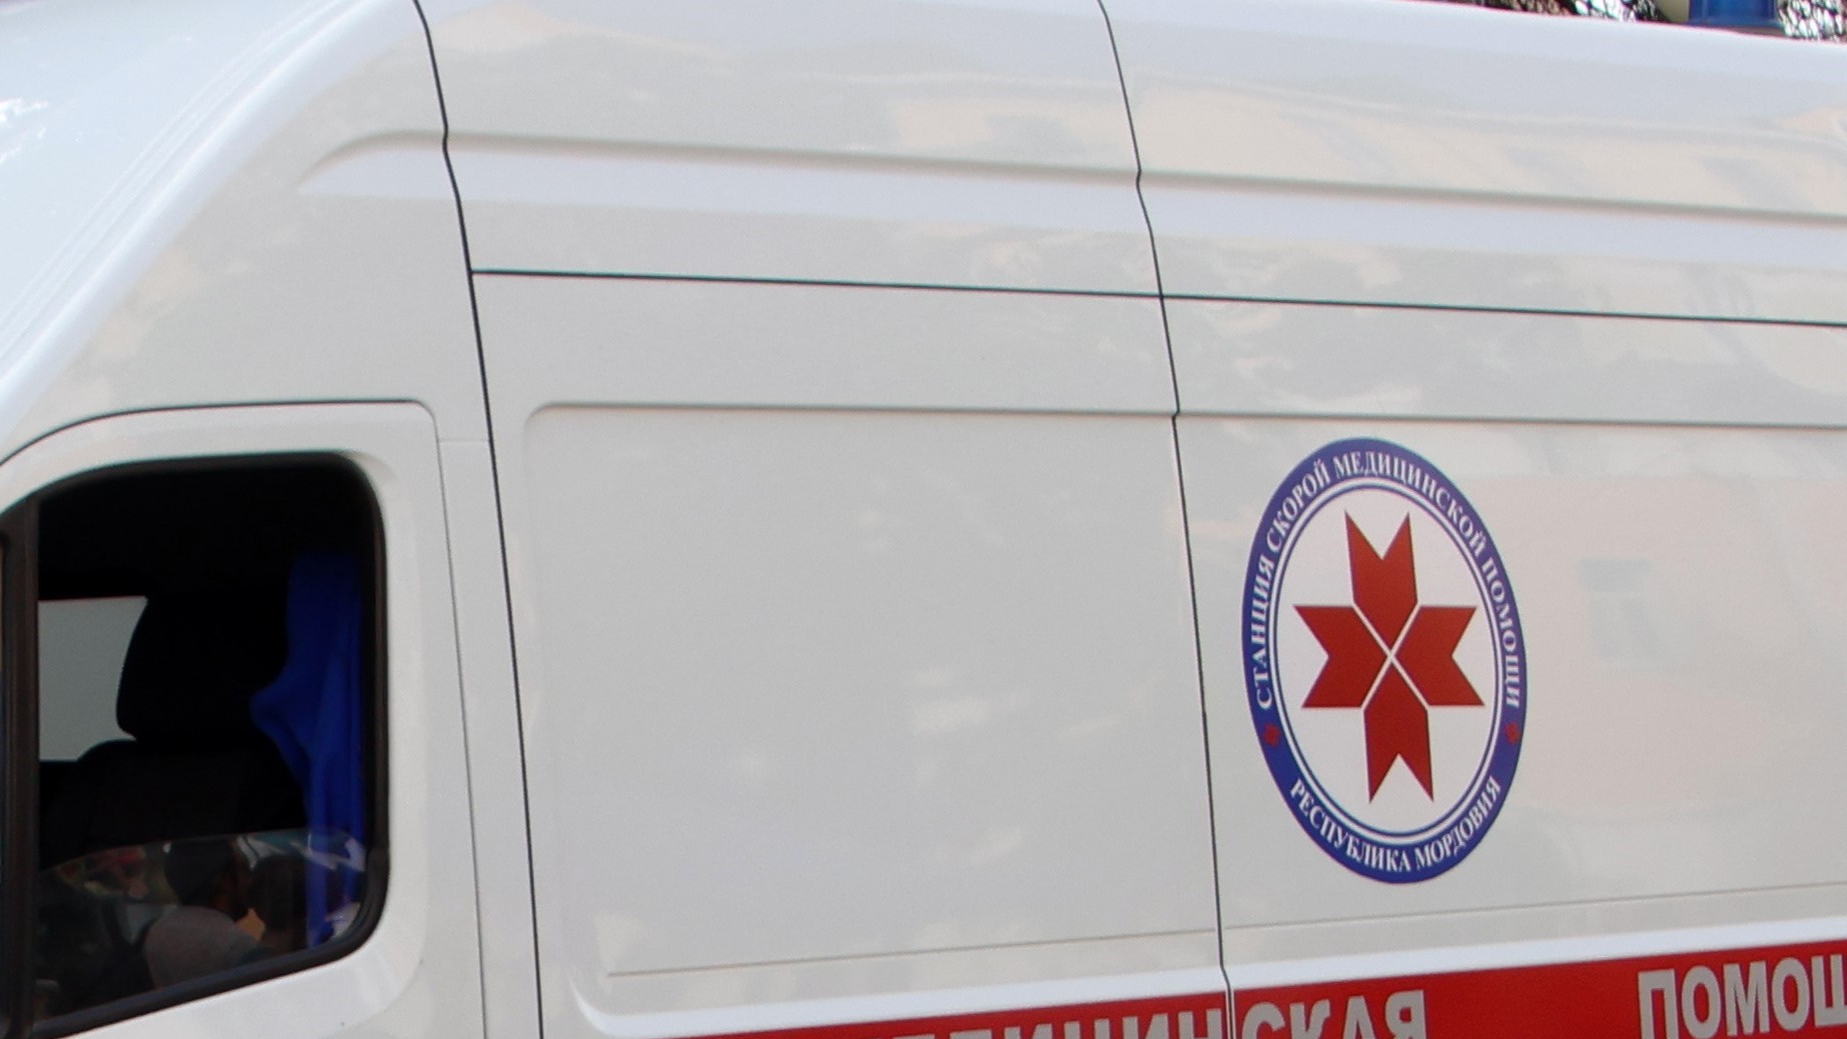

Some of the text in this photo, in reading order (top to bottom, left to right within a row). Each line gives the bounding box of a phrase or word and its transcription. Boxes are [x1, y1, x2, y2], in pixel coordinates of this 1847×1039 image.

[1250, 451, 1521, 710] СТАНЦИЯ СКОРОЙ МЕДИЦИНСКОЙ ПОМОЩИ
[1289, 774, 1502, 873] РЕСПУБЛИКА МОРДОВИЯ
